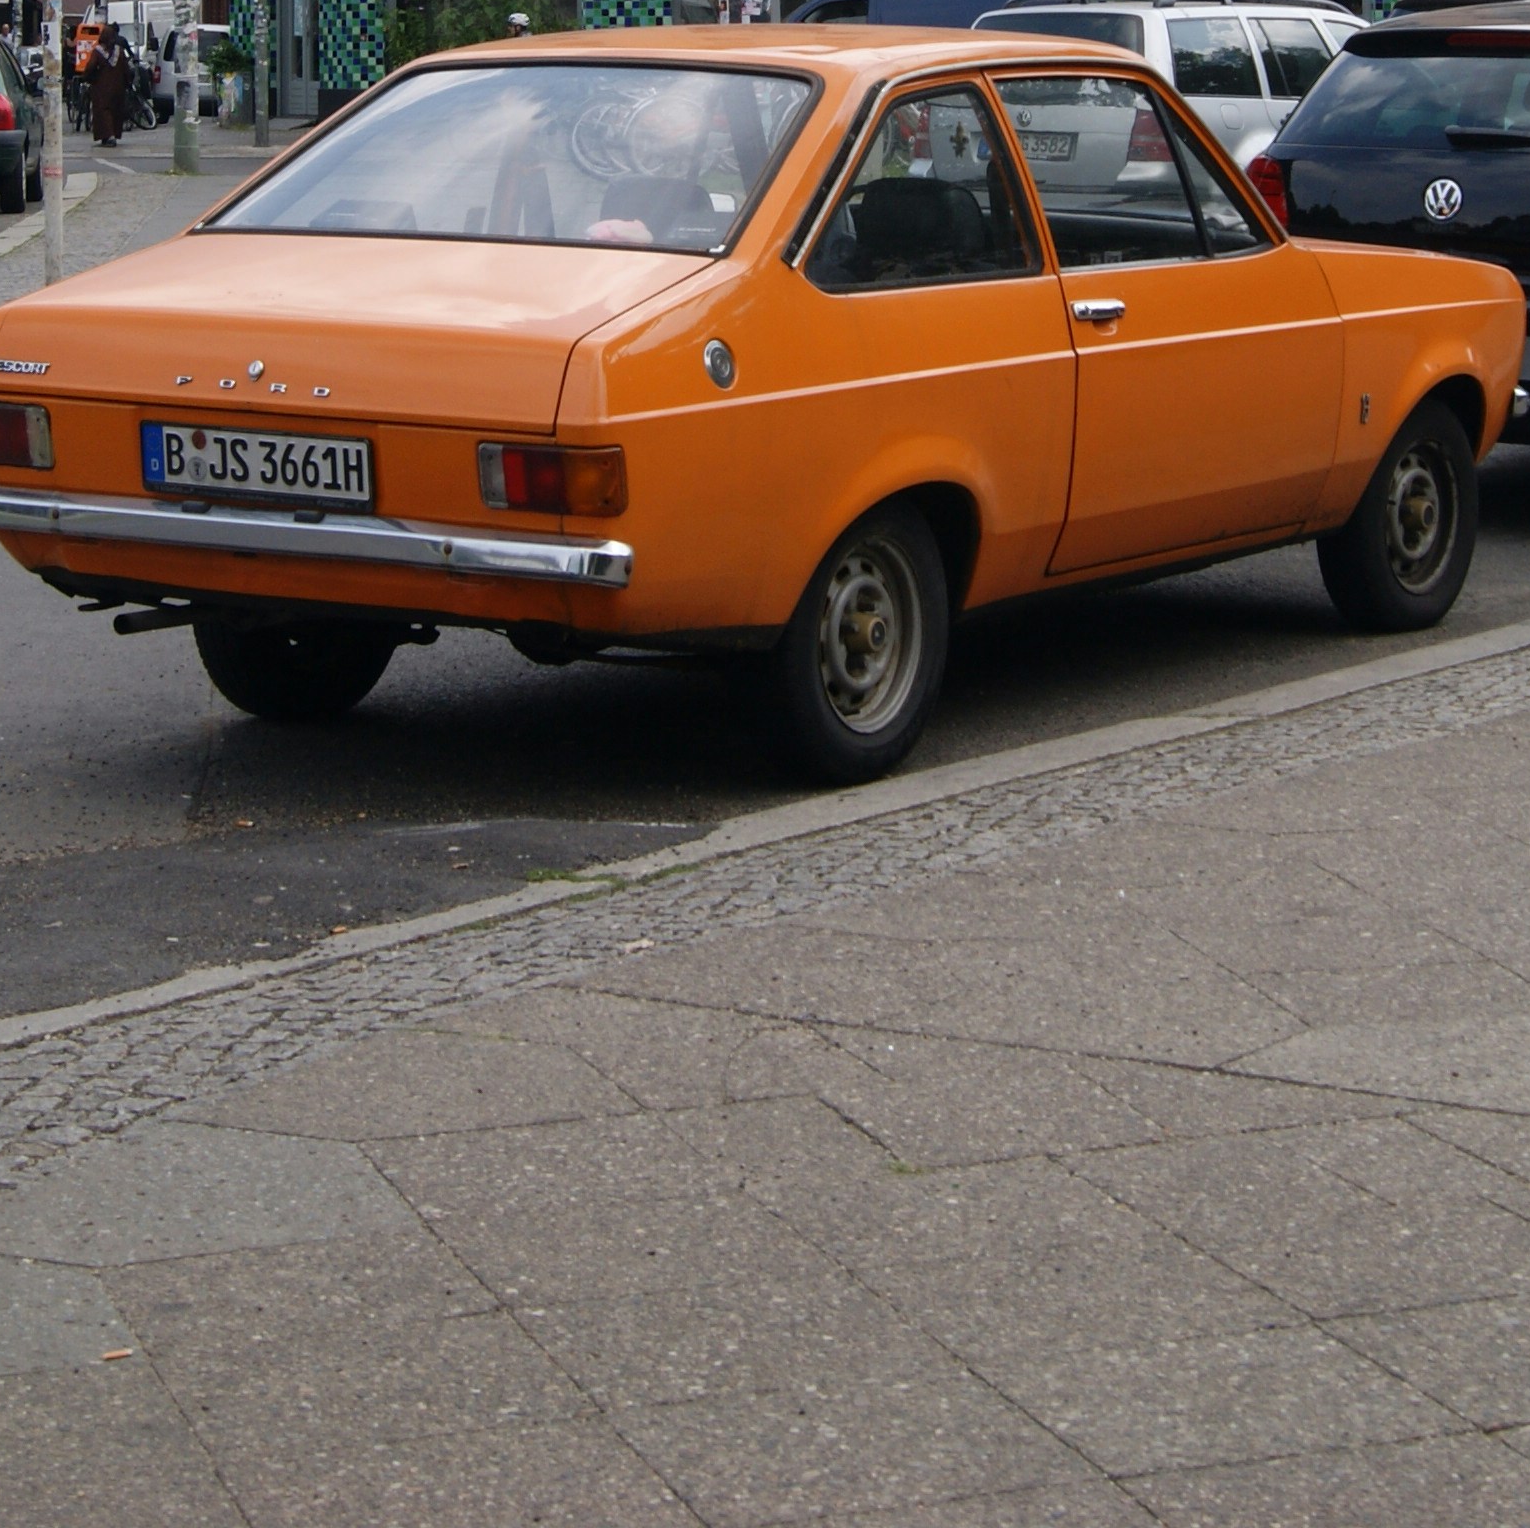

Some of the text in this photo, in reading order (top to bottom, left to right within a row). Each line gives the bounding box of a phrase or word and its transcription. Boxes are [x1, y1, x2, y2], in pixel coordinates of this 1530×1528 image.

[1031, 136, 1069, 153] 3582
[165, 432, 185, 476] B
[209, 437, 249, 483] JS
[258, 441, 364, 493] 3661H
